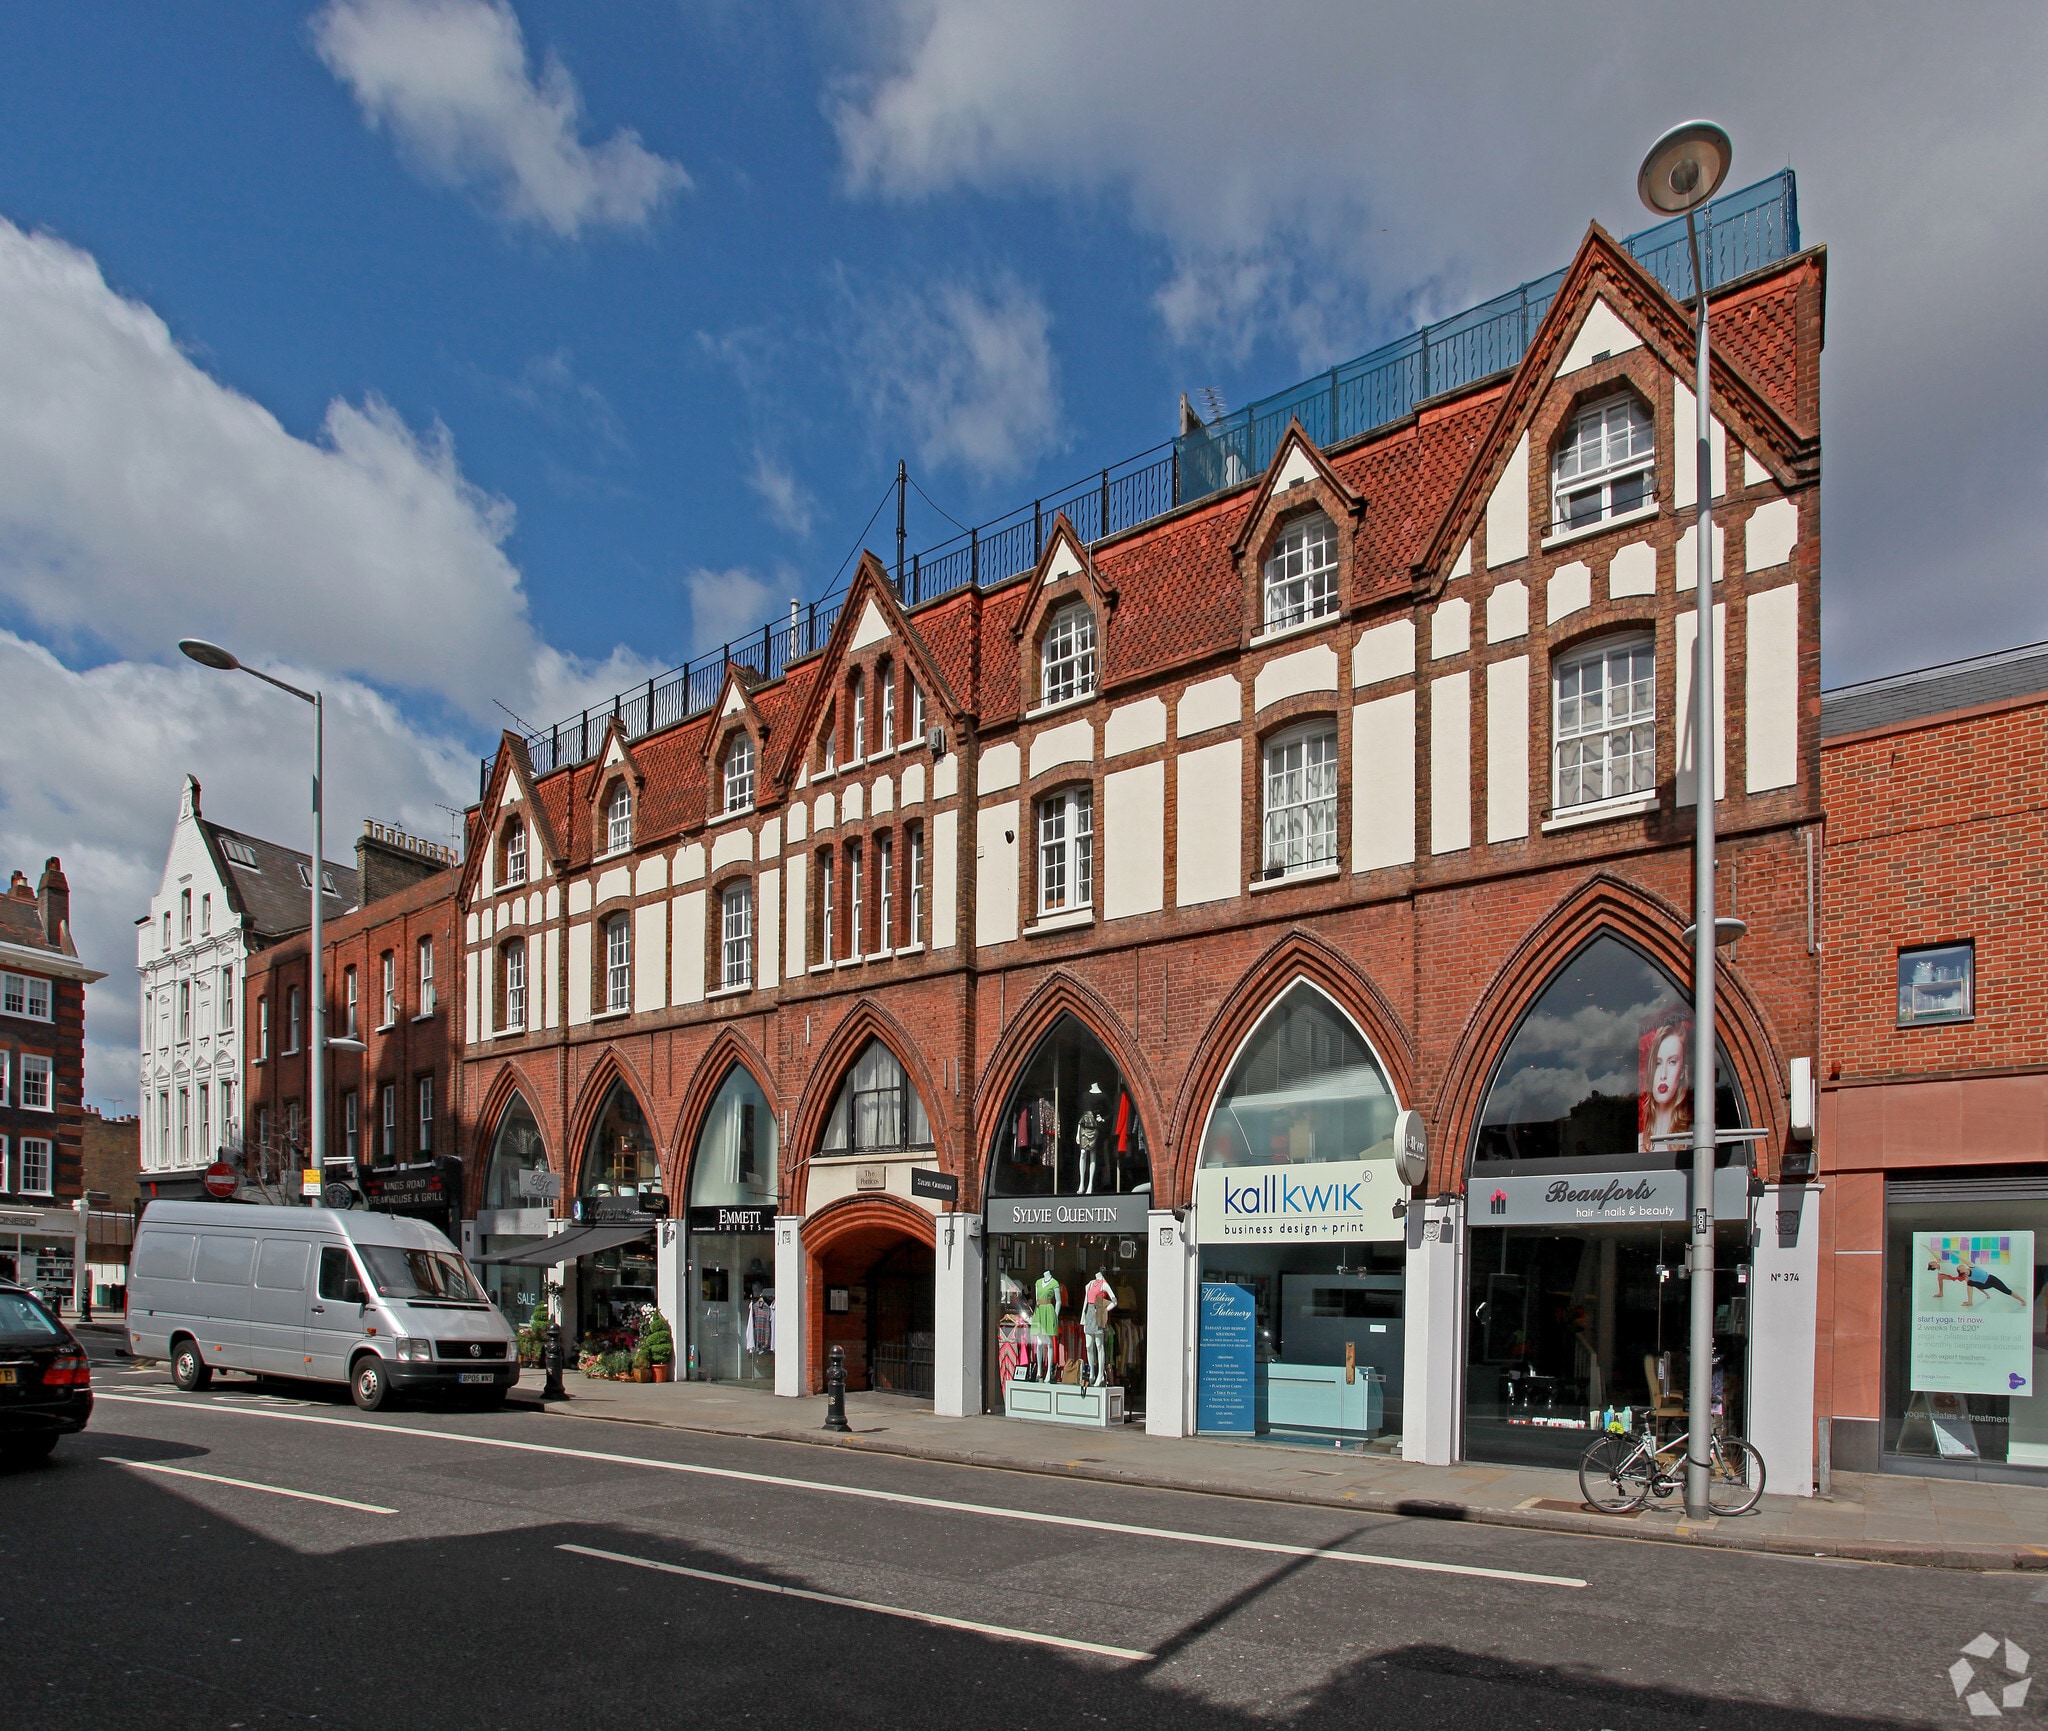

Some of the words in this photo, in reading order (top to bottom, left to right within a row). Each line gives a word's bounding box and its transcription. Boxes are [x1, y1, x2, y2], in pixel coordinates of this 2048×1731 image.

[864, 1169, 875, 1177] The
[383, 1181, 405, 1190] KINGS
[406, 1179, 426, 1189] ROAD
[368, 1194, 413, 1205] STEAKHOUSE
[414, 1193, 420, 1203] &
[421, 1192, 443, 1202] GRILL
[1545, 1178, 1657, 1210] Beauforts
[719, 1209, 761, 1224] EMMETT
[1013, 1206, 1052, 1223] SYLVIE
[1056, 1205, 1118, 1223] QUENTIN
[1576, 1207, 1594, 1218] hair
[1604, 1206, 1626, 1217] nails
[1629, 1206, 1636, 1216] &
[1639, 1205, 1674, 1217] beauty
[1225, 1224, 1273, 1235] business
[1280, 1223, 1318, 1235] design
[1322, 1225, 1328, 1233] +
[1332, 1222, 1364, 1235] print
[1783, 1273, 1799, 1282] 374
[517, 1292, 536, 1306] SALE
[1202, 1287, 1235, 1306] Wedding
[1209, 1302, 1252, 1320] Stationery
[1903, 1410, 1927, 1420] yoga,
[1930, 1410, 1958, 1420] pilates
[1968, 1413, 2017, 1424] treatments
